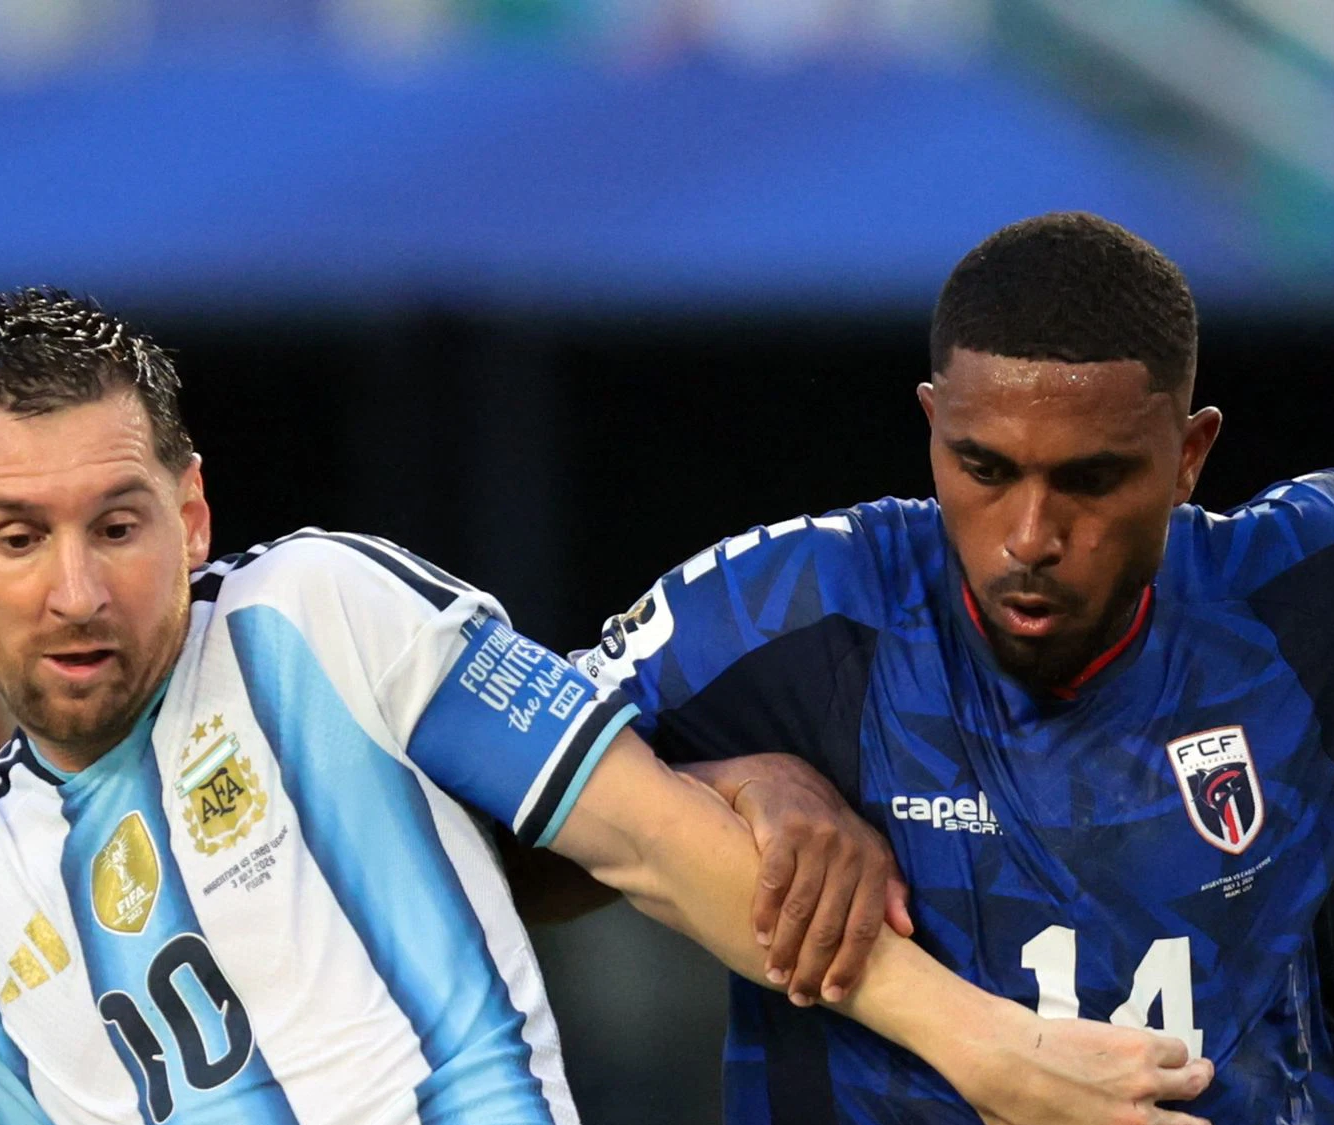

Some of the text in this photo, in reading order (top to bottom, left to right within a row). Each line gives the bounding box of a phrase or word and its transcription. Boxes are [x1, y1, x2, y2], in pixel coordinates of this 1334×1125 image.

[459, 624, 517, 693] FOOTBALL
[479, 639, 546, 711] UNITES
[508, 697, 541, 732] the
[555, 686, 581, 713] FIFA
[1177, 735, 1237, 764] FCF
[197, 767, 244, 824] AFA
[116, 886, 145, 915] FIFA
[1021, 924, 1203, 1061] 14
[98, 933, 253, 1124] 10
